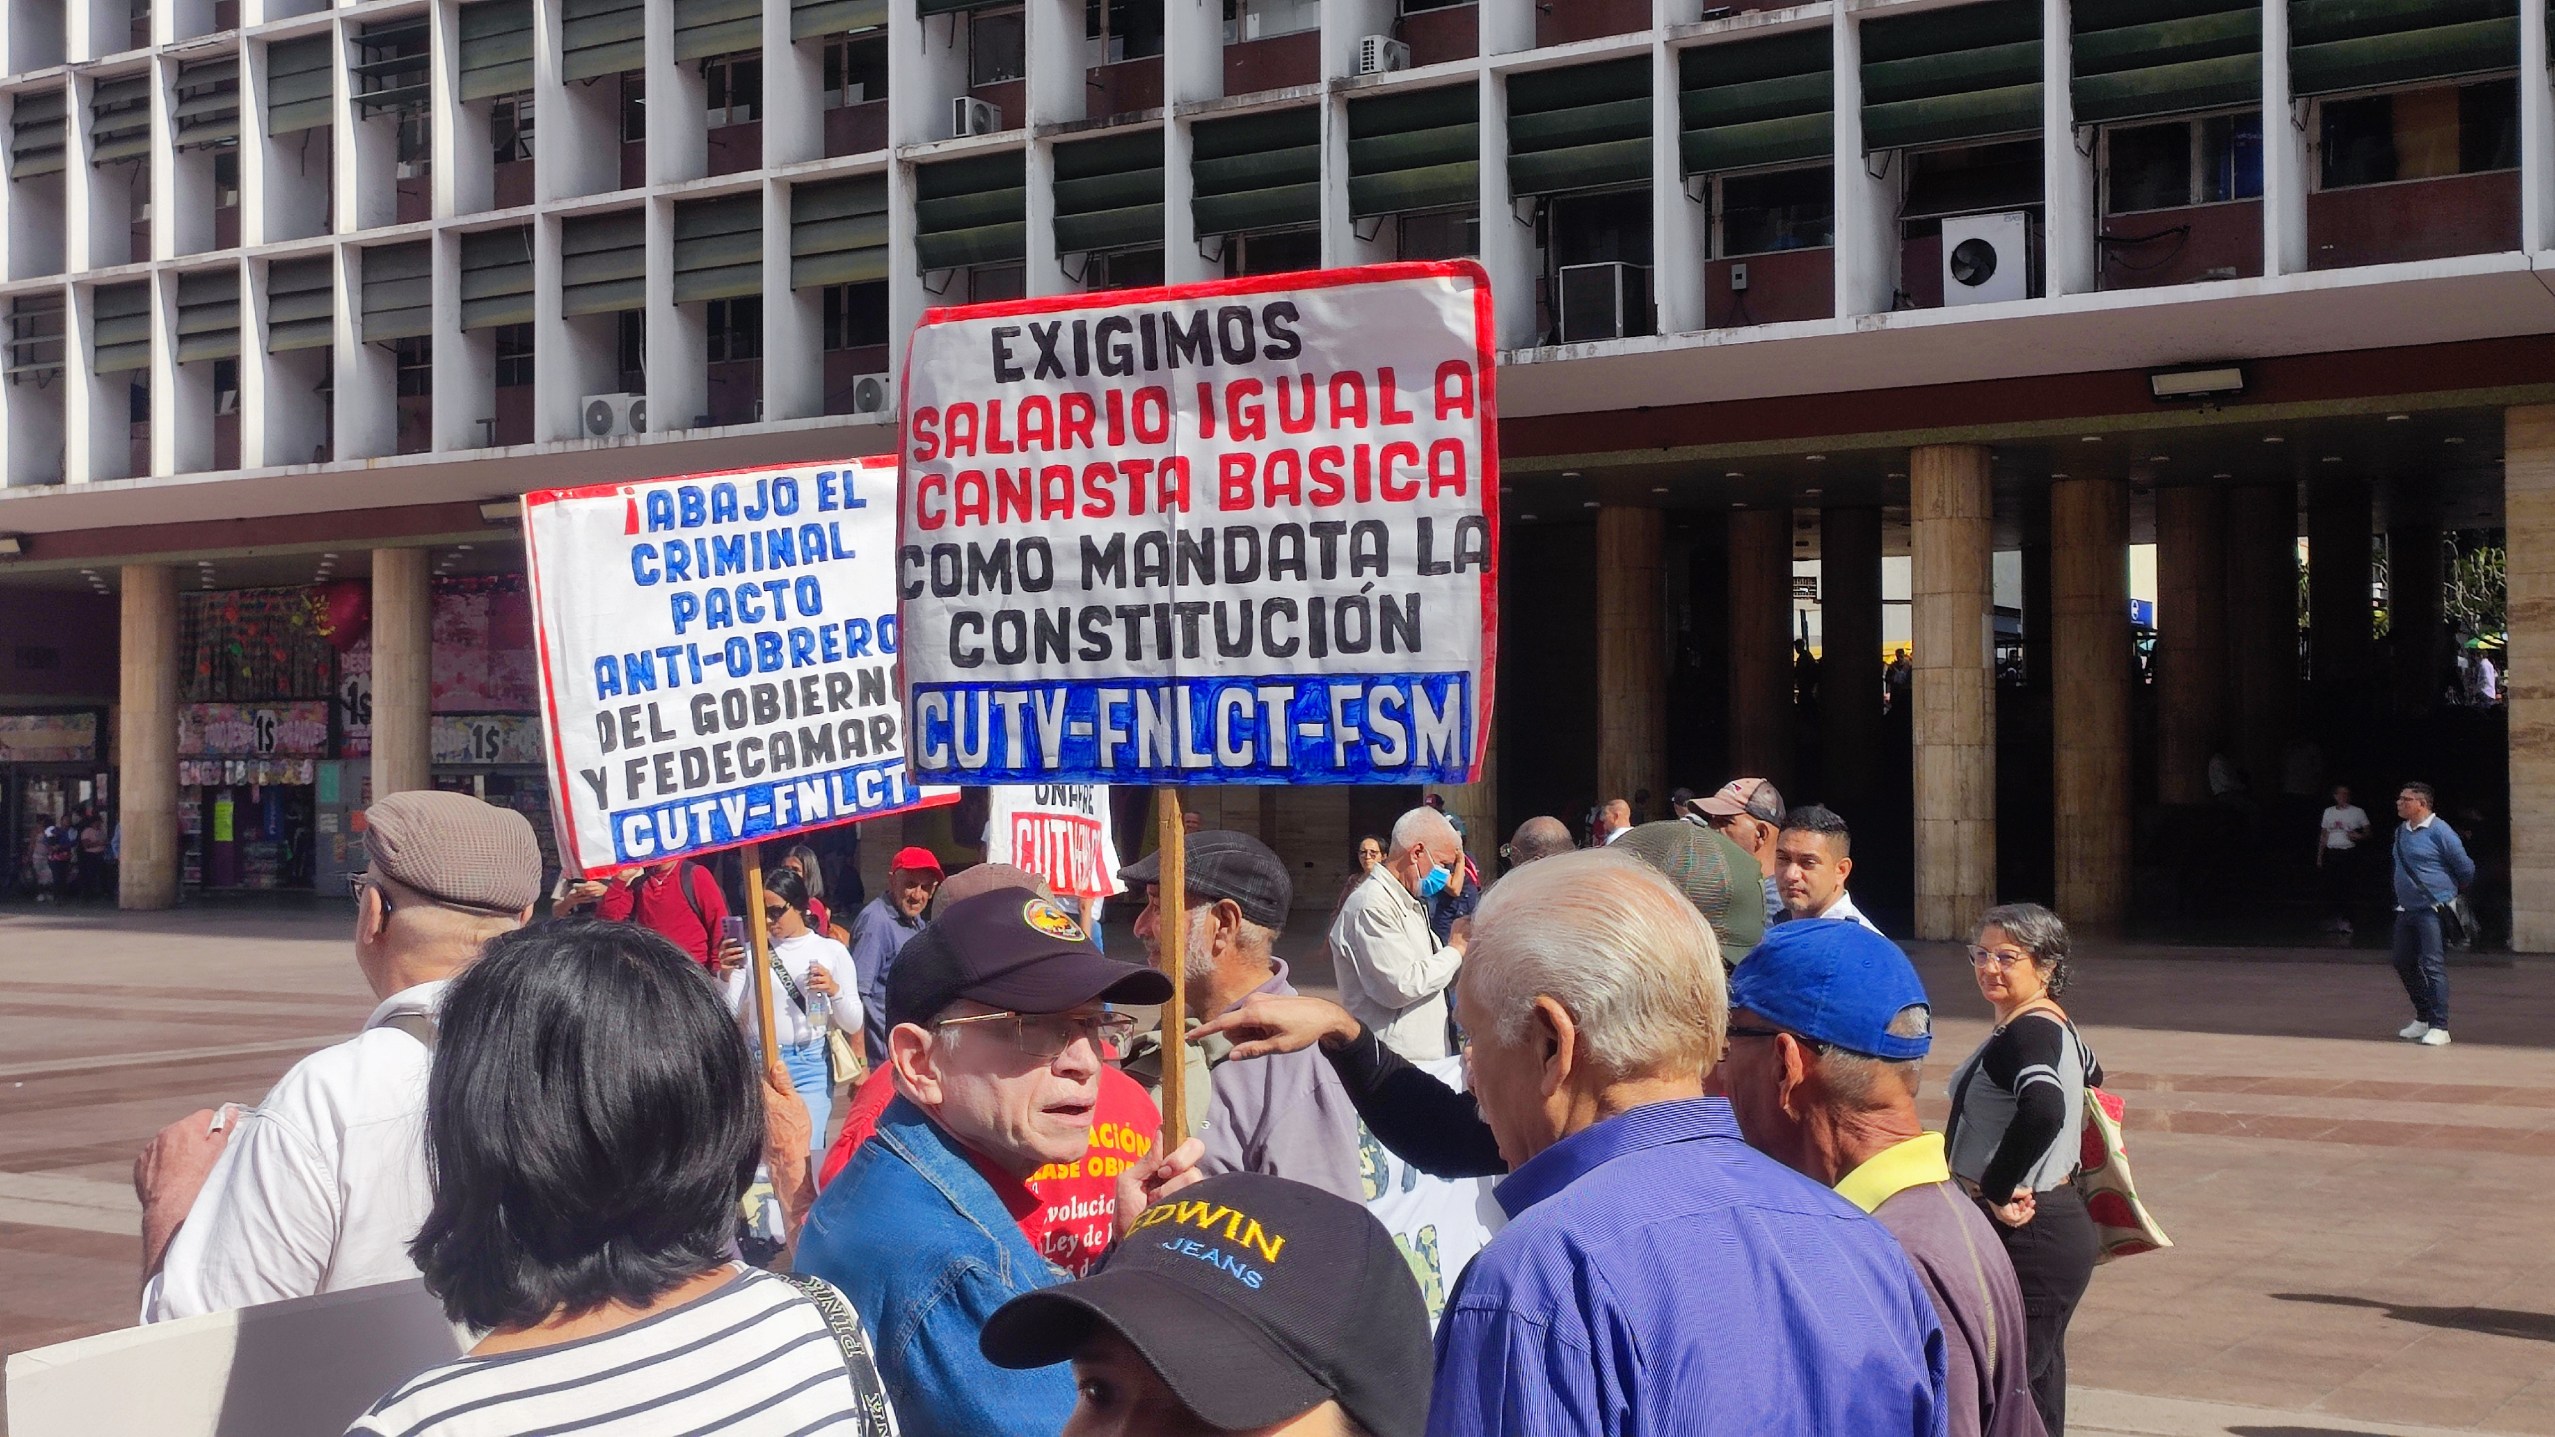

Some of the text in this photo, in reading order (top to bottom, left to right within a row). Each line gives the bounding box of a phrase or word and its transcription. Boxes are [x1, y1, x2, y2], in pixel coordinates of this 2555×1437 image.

[991, 301, 1301, 384] EXIGIMOS
[912, 360, 1474, 462] SALARIO IGUAL A
[816, 470, 867, 512] EL
[917, 438, 1467, 531] CANASTA BASICA
[631, 522, 856, 586] CRIMINAL
[896, 515, 1491, 600] COMO MANDATA LA
[671, 575, 824, 635] PACTO
[949, 582, 1422, 669] CONSTITUCIÓN
[594, 614, 897, 701] ANTI-OBRERO
[472, 724, 500, 762] 1$
[596, 701, 677, 755] DEL
[918, 683, 1461, 769] CUTV-FNLCT-FSM
[580, 766, 608, 811] Y
[622, 766, 906, 858] CUTV-FNLCT
[1043, 1230, 1079, 1258] Ley
[1083, 1224, 1103, 1248] de
[1044, 1194, 1115, 1224] volucio
[1123, 1200, 1287, 1264] EDWIN
[1162, 1238, 1264, 1289] JEANS
[804, 1276, 866, 1358] PINK
